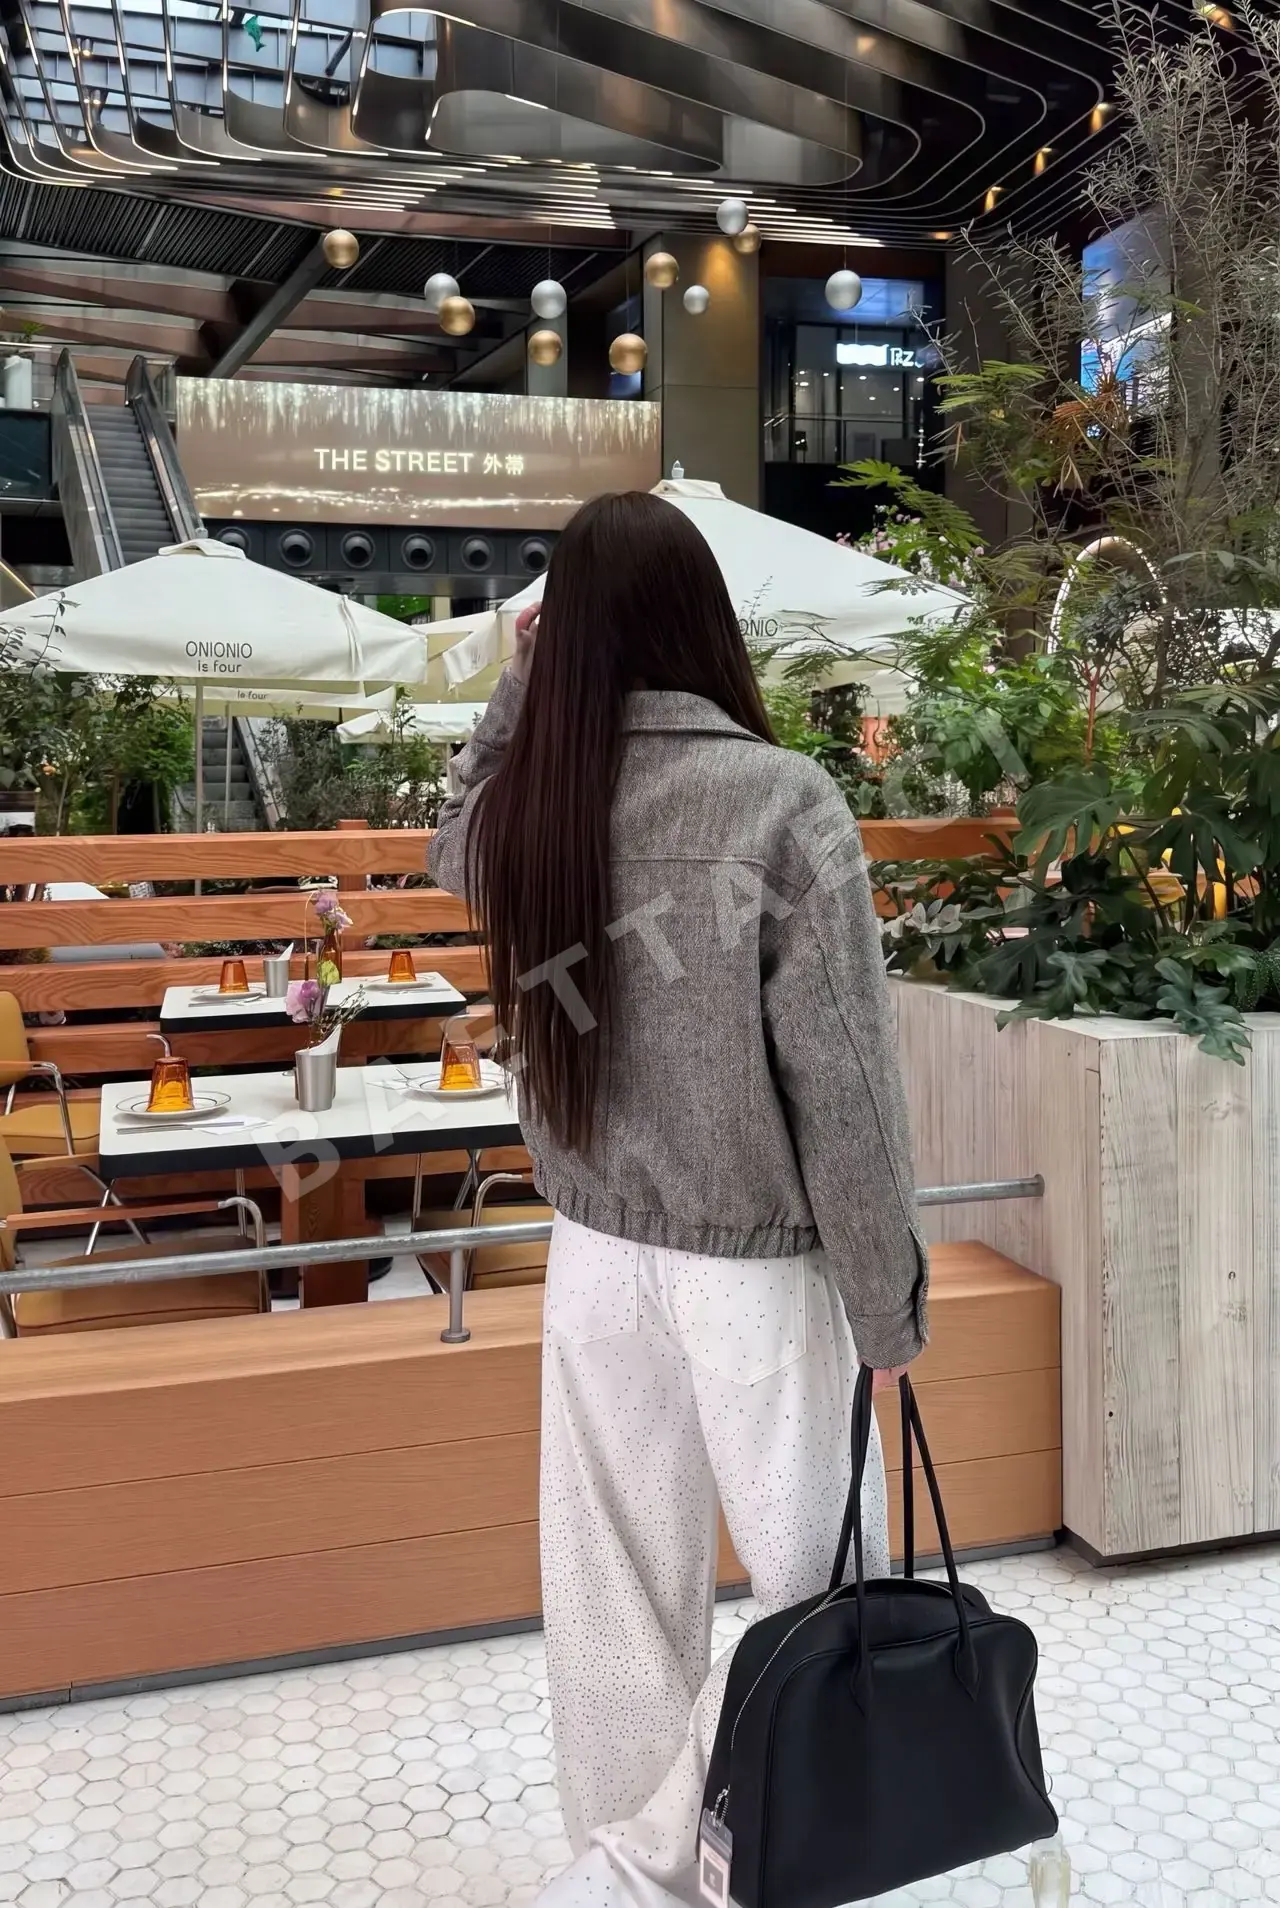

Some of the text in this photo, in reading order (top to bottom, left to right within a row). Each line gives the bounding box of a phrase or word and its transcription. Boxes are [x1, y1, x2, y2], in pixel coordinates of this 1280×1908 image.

[313, 448, 367, 470] THE
[375, 449, 474, 473] STREET
[738, 618, 778, 637] ONIO
[185, 640, 253, 659] ONIONIO
[197, 659, 242, 673] is four
[248, 690, 268, 700] four
